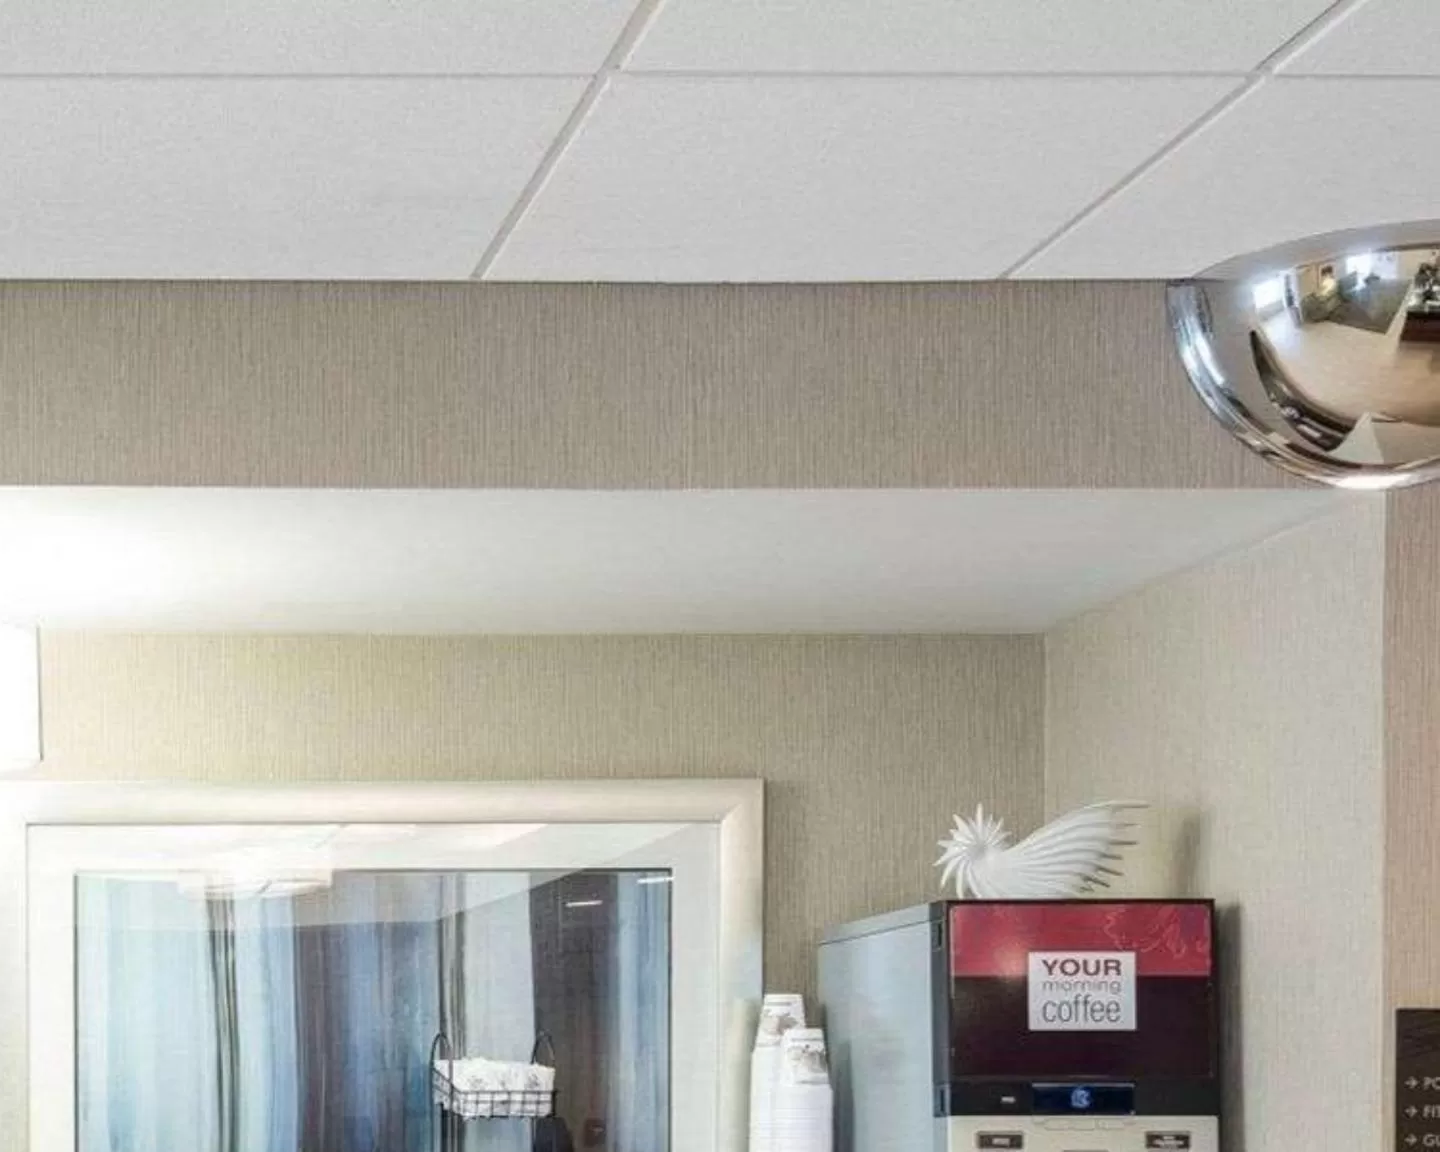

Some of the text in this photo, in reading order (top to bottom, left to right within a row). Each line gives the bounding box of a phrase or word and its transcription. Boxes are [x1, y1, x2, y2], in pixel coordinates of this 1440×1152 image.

[1042, 958, 1122, 976] YOUR
[1042, 980, 1122, 995] morning
[1042, 993, 1121, 1022] coffee
